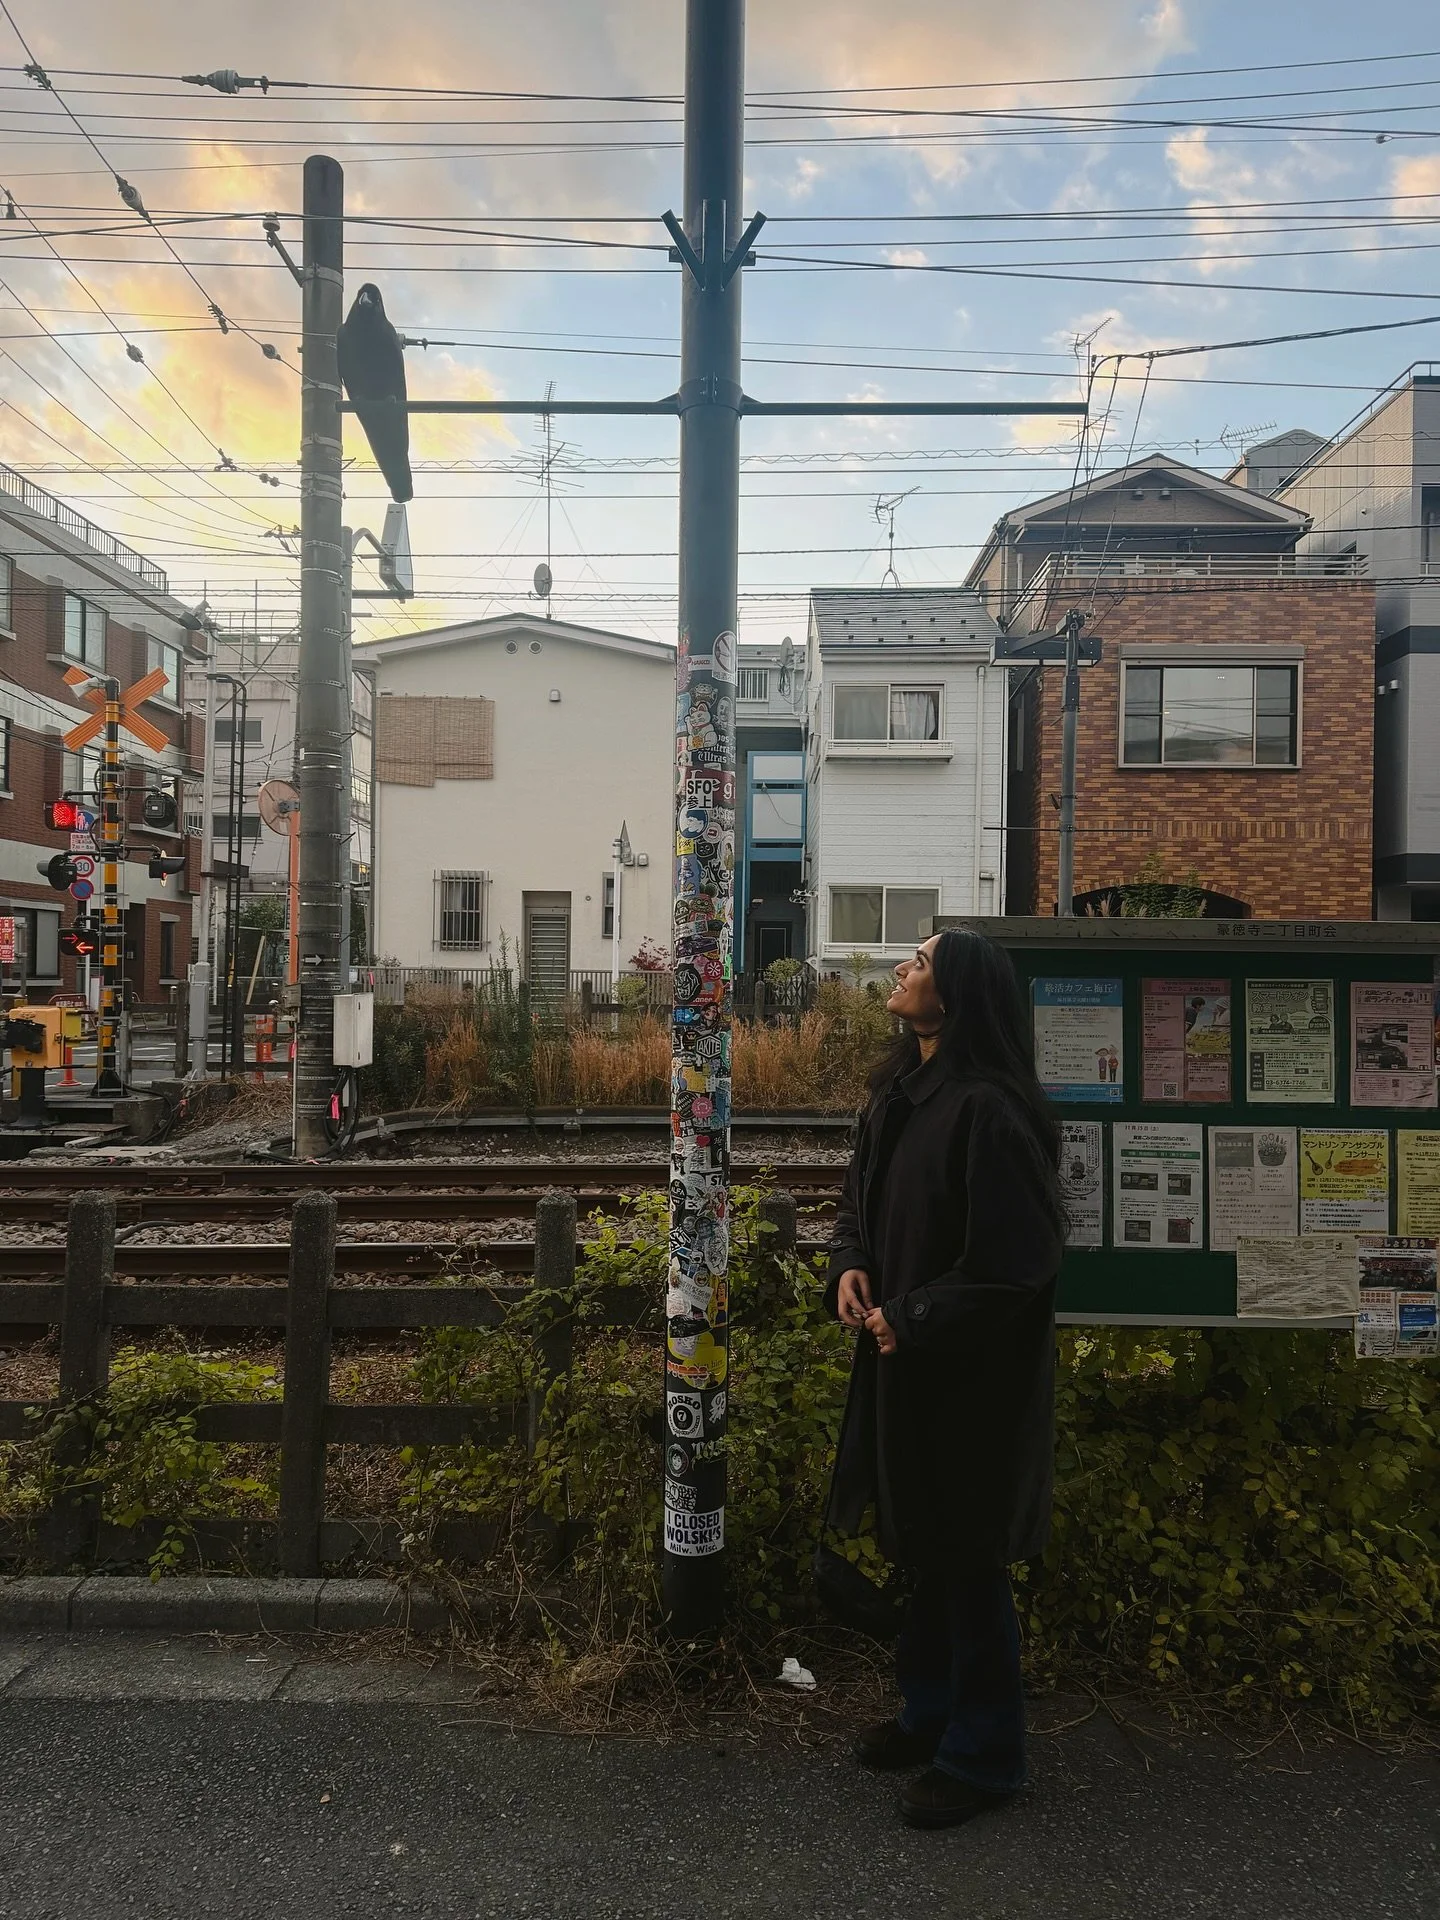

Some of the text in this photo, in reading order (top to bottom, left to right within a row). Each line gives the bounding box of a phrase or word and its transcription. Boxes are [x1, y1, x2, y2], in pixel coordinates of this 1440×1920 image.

[687, 779, 712, 794] SFO
[687, 795, 712, 810] 参上
[77, 861, 90, 872] 30
[1216, 923, 1338, 938] 豪徳寺二丁目町会
[1252, 990, 1308, 1002] スマートフォン
[1303, 1141, 1385, 1149] マンドリン アンサンブル
[678, 1412, 685, 1421] 7
[668, 1511, 720, 1530] I CLOSED
[667, 1524, 721, 1545] WOLSKI'S
[670, 1543, 692, 1554] Milw.
